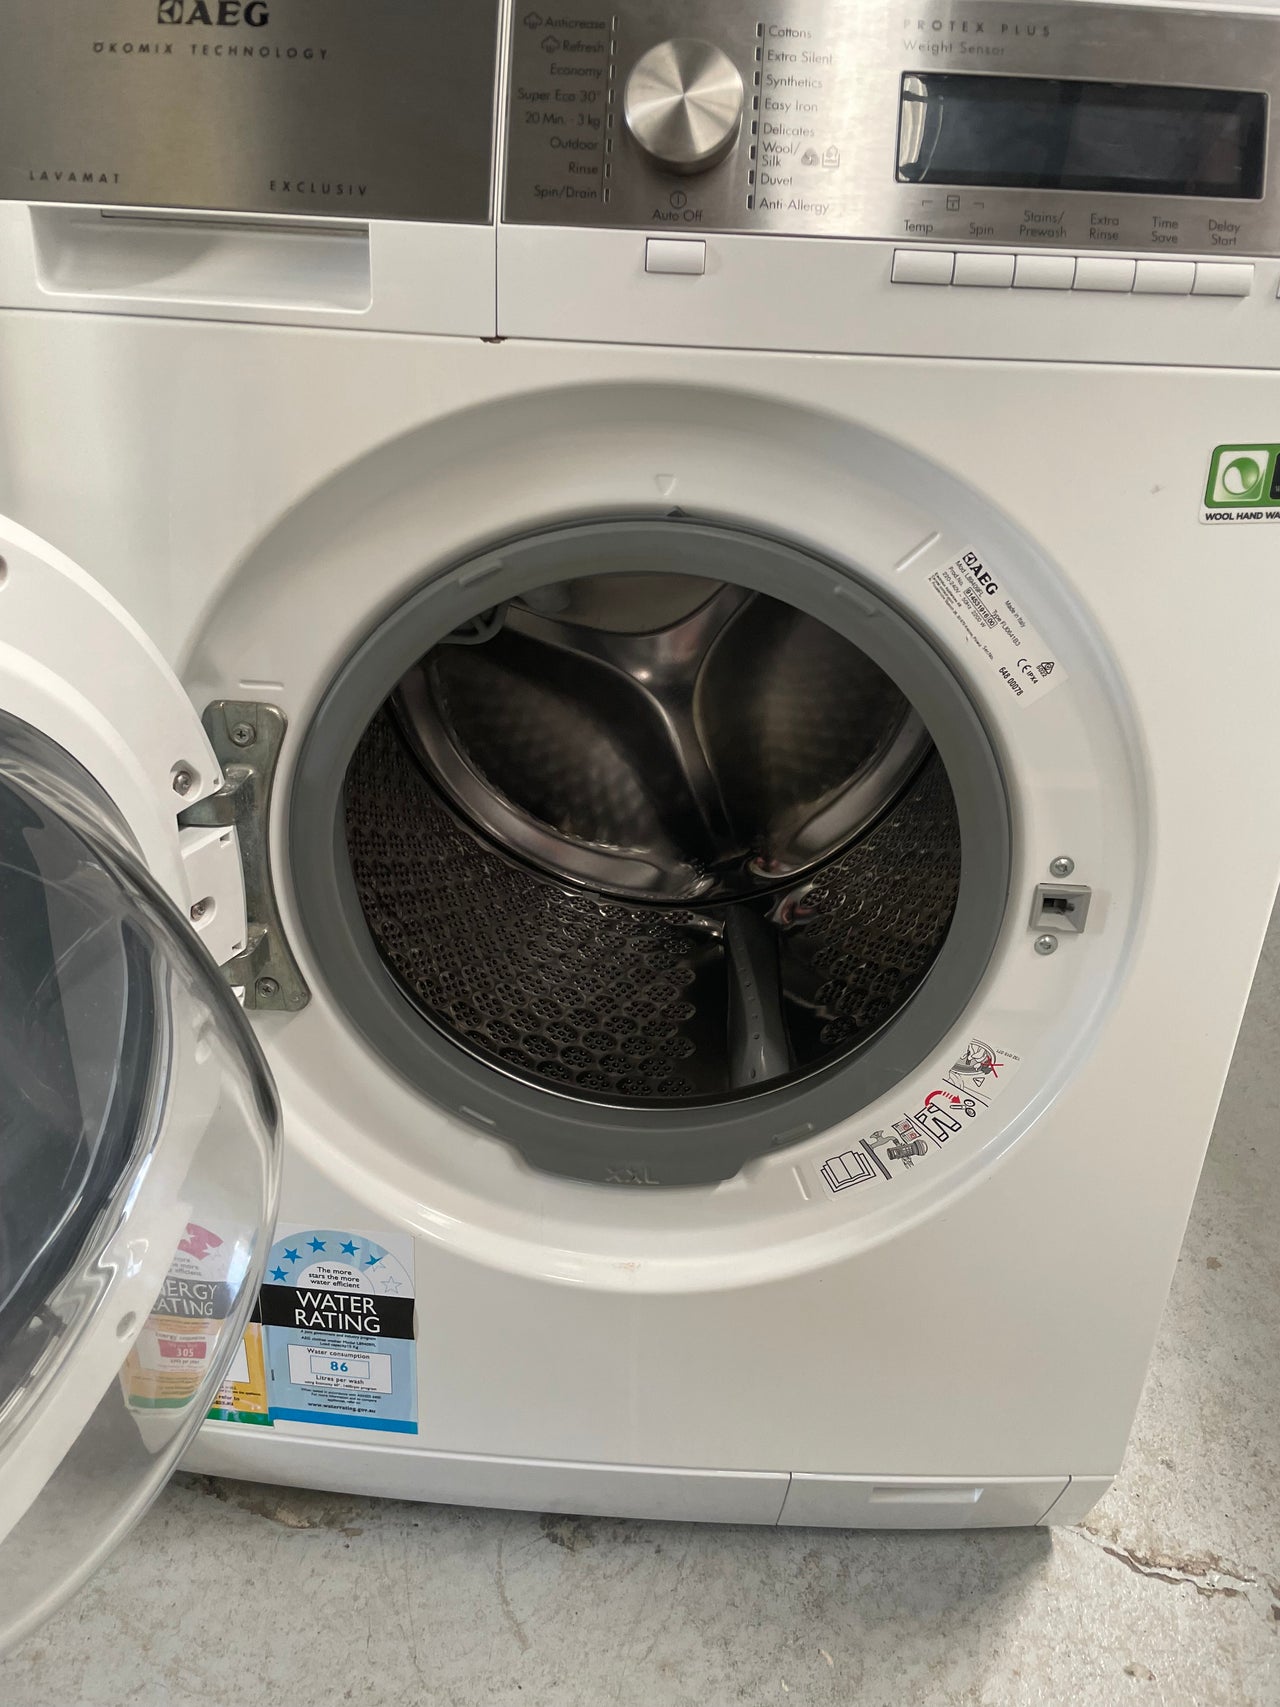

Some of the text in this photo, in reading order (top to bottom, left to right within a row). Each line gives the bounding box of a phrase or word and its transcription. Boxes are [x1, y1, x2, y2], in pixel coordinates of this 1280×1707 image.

[185, 0, 270, 27] AEG
[545, 16, 605, 29] Anticrease
[903, 20, 1050, 38] PROTEX PLUS
[768, 25, 813, 39] Cottons
[191, 44, 328, 60] TECHNOLOGY
[563, 39, 604, 53] Refresh
[903, 40, 1005, 56] Weight Sensor
[767, 49, 833, 65] Extra Silent
[550, 63, 602, 79] Economy
[766, 73, 824, 90] Synthetics
[518, 88, 549, 102] Super
[555, 89, 576, 101] Eco
[765, 97, 819, 113] Easy Iron
[526, 112, 540, 124] 20
[578, 113, 585, 126] 3
[588, 113, 600, 130] kg
[763, 122, 815, 137] Delicates
[550, 136, 598, 150] Outdoor
[762, 141, 801, 156] Wool/
[568, 161, 599, 174] Rinse
[762, 154, 782, 168] Silk
[29, 170, 121, 184] LAVAMAT
[760, 172, 793, 186] Duvet
[270, 180, 367, 196] EXCLUSIV
[534, 185, 597, 200] Spin/Drain
[652, 208, 703, 222] Auto Off
[1024, 210, 1065, 224] Stains/
[1090, 213, 1119, 226] Extra
[904, 219, 934, 237] Temp
[969, 222, 994, 237] Spin
[1152, 216, 1179, 229] Time
[1208, 219, 1241, 235] Delay
[1019, 224, 1067, 239] Prewash
[1089, 228, 1119, 241] Rinse
[1151, 231, 1178, 244] Save
[1211, 234, 1237, 246] Start
[1236, 512, 1263, 520] HAND
[969, 564, 998, 595] AEG
[992, 609, 1002, 622] Type
[1005, 600, 1015, 614] Made
[1017, 617, 1025, 628] Italy
[999, 667, 1011, 679] 648
[1026, 670, 1038, 684] IPX4
[152, 1297, 214, 1316] ATING
[295, 1291, 377, 1315] WATER
[295, 1309, 380, 1333] RATING
[176, 1348, 194, 1358] 305
[307, 1347, 370, 1359] Water consumption
[330, 1361, 349, 1372] 86
[308, 1403, 376, 1413] www.waterrating.gov.au
